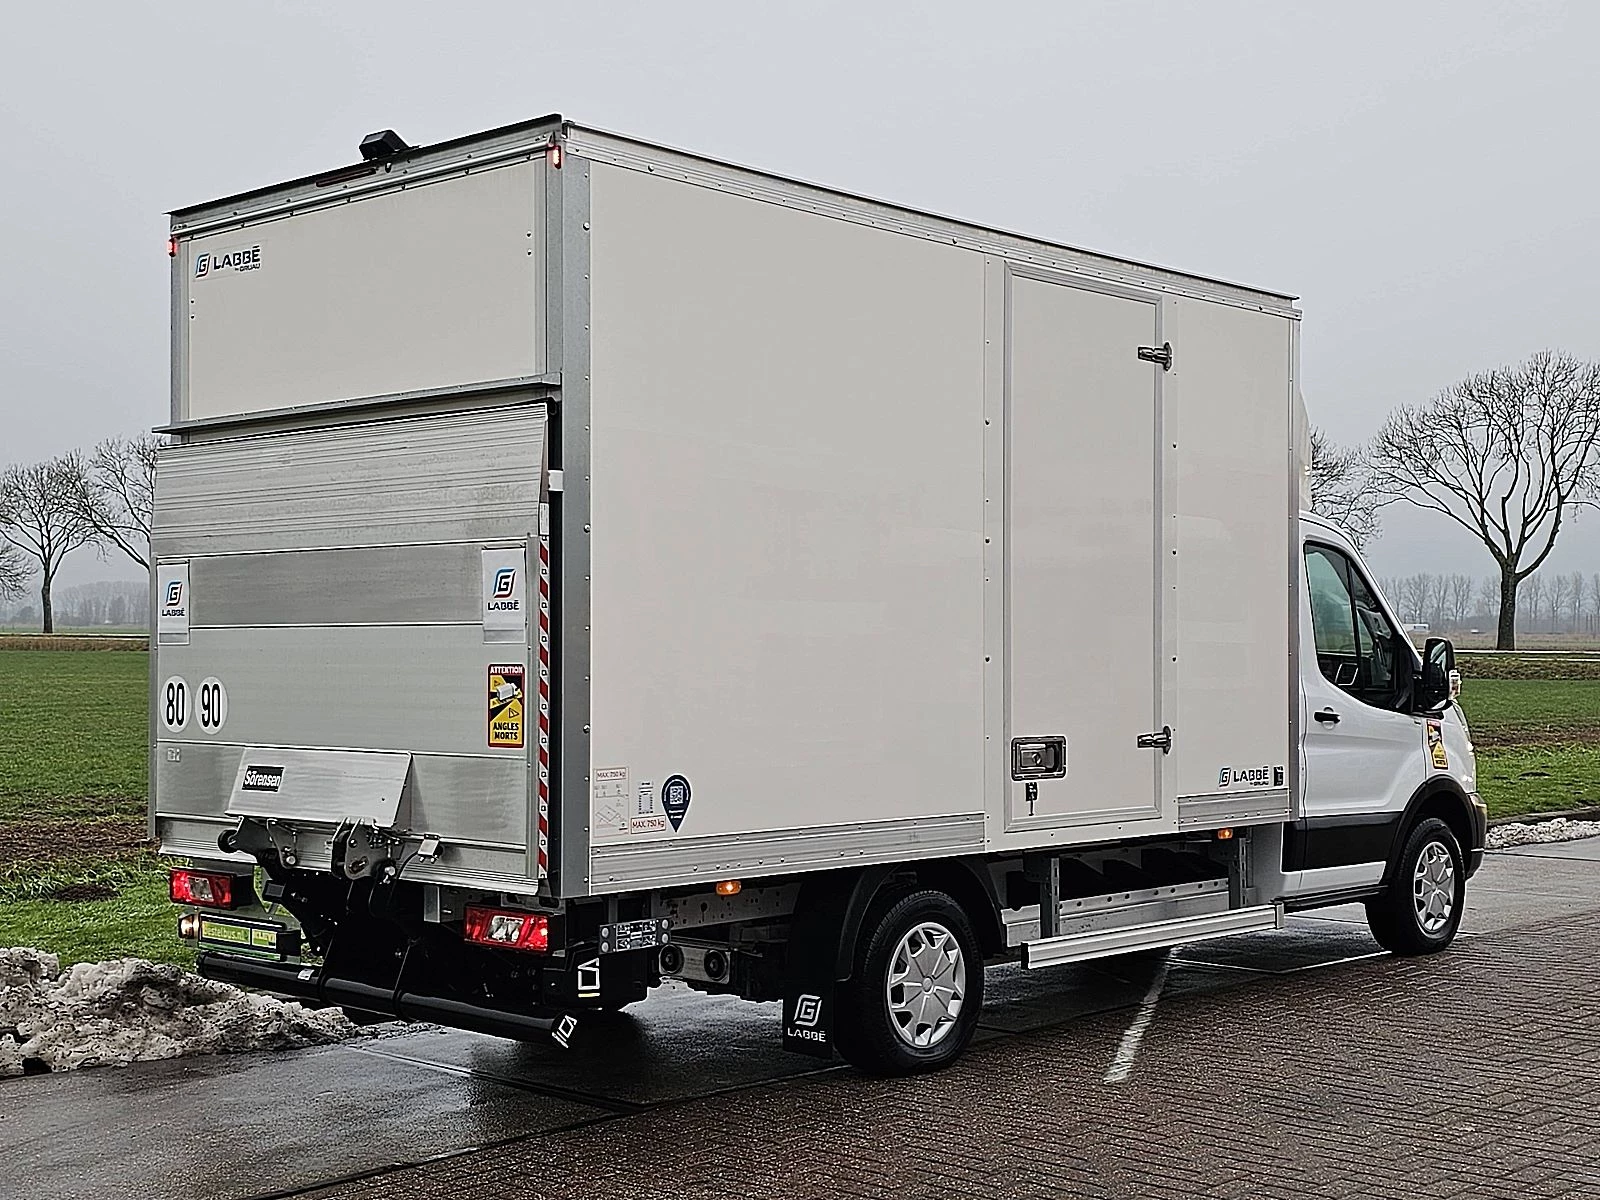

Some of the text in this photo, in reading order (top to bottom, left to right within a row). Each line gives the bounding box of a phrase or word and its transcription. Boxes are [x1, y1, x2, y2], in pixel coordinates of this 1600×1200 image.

[213, 245, 260, 270] LABBÉ
[161, 608, 185, 616] LABBÉ
[488, 600, 520, 610] LABBÉ
[490, 666, 523, 674] ATTENTION
[166, 682, 185, 726] 80
[201, 683, 220, 727] 90
[493, 722, 519, 731] ANGLES
[494, 731, 518, 740] MORTS
[244, 770, 281, 787] Sörensen
[1233, 766, 1269, 782] LABBÉ
[787, 1027, 826, 1042] LABBÉ
